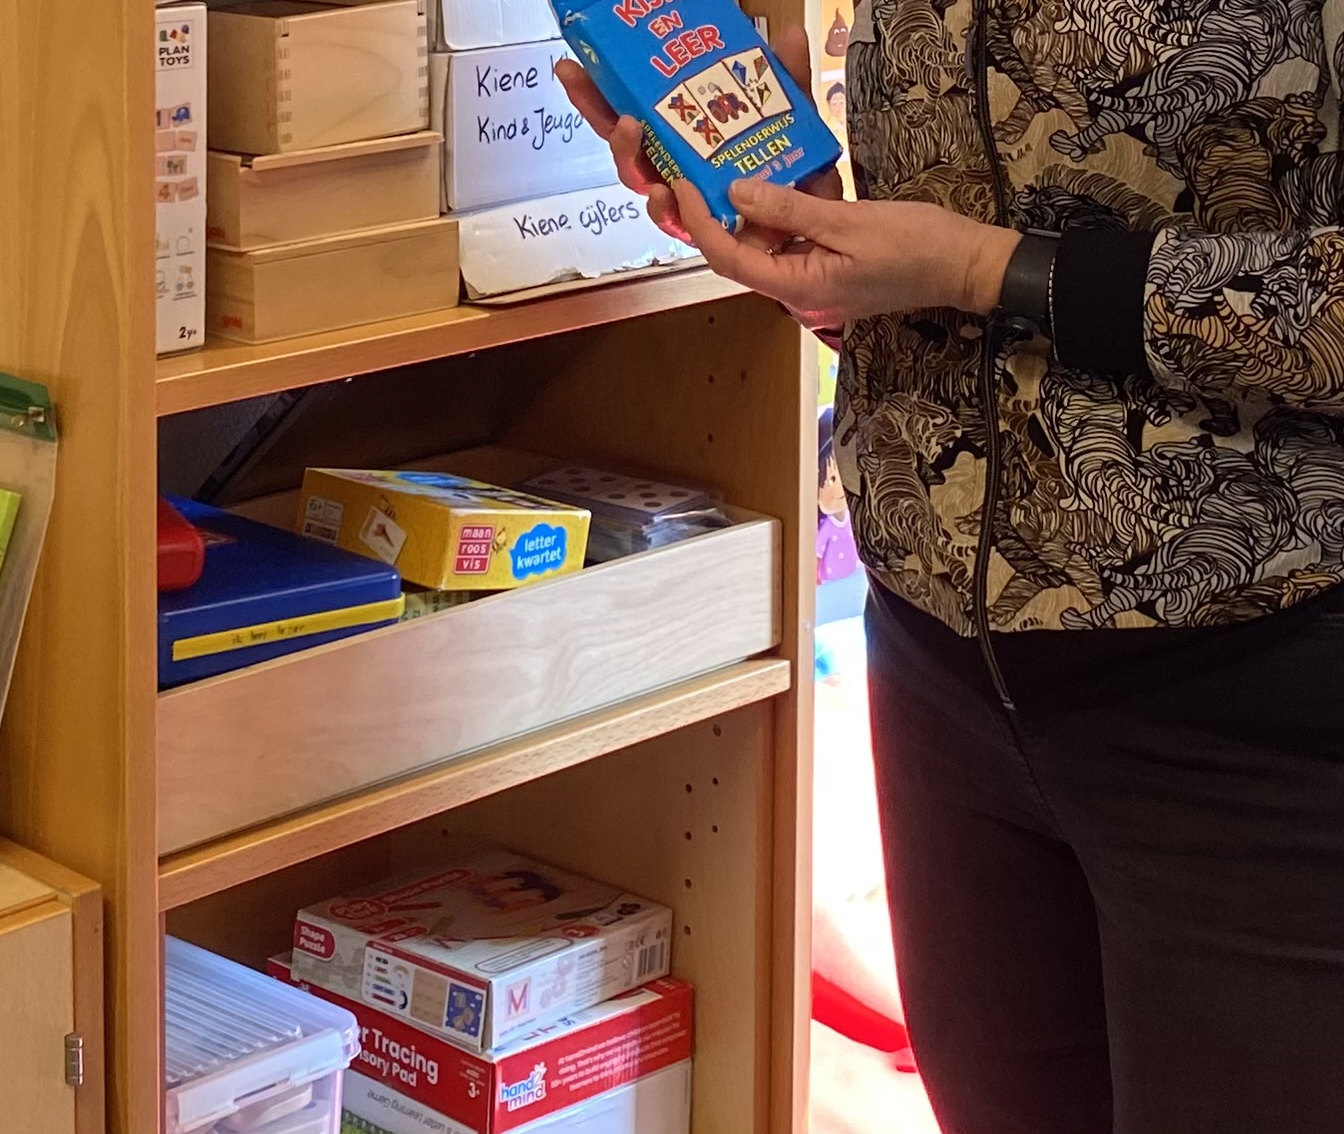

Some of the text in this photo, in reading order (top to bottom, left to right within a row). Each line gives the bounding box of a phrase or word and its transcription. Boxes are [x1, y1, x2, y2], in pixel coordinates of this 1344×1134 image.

[648, 11, 683, 38] EN
[159, 45, 190, 56] PLAN
[159, 55, 190, 67] TOYS
[650, 25, 725, 78] LEER
[476, 66, 538, 98] Kiene
[711, 113, 796, 169] SPELENDERWIJS
[733, 134, 792, 175] TELLEN
[159, 183, 171, 200] 4
[513, 214, 570, 240] Kiene
[462, 527, 492, 539] maan
[461, 543, 487, 555] roos
[524, 535, 557, 553] letter
[462, 558, 481, 570] vis
[517, 547, 562, 570] kwartet
[301, 926, 325, 942] Shape
[299, 937, 326, 954] Puzzle
[372, 1028, 439, 1085] Tracing
[359, 1050, 417, 1088] sory Pad
[367, 1089, 392, 1108] Game
[509, 1082, 544, 1110] mind
